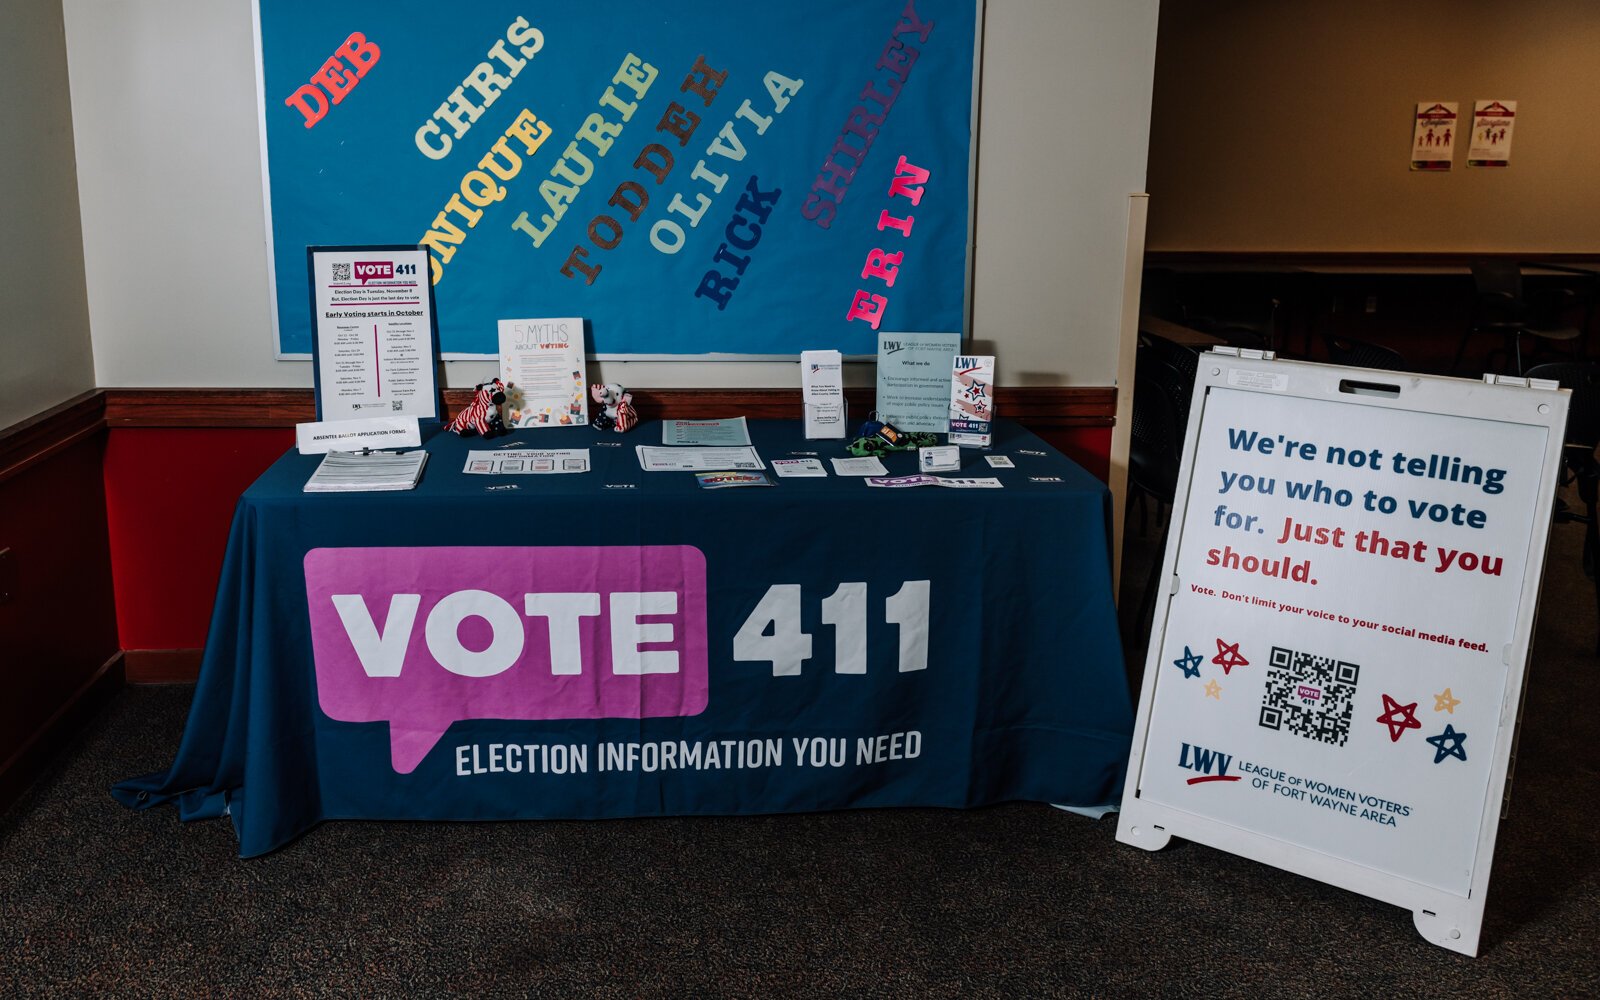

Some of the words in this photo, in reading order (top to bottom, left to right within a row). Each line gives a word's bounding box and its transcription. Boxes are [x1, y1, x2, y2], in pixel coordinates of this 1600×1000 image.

[285, 31, 381, 129] DEB
[414, 15, 545, 161] CHRIS
[801, 0, 935, 230] SHIRLEY
[511, 52, 659, 249] LAURIE
[650, 70, 804, 255] OLIVIA
[694, 175, 782, 311] RICK
[846, 155, 931, 330] ERIN
[356, 265, 392, 275] VOTE
[395, 264, 416, 275] 411
[343, 310, 367, 318] Voting
[514, 324, 524, 342] 5
[526, 323, 569, 343] MYTHS
[539, 342, 569, 350] VOTING
[883, 341, 902, 350] LWV
[955, 357, 978, 369] LWV
[313, 433, 338, 441] ABSENTEE
[357, 430, 388, 438] APPLICATION
[1227, 428, 1317, 461] We're
[1326, 441, 1383, 470] not
[1392, 451, 1507, 496] telling
[1218, 470, 1275, 495] you
[1285, 479, 1352, 507] who
[1363, 490, 1397, 514] to
[1408, 500, 1487, 529] vote
[1213, 504, 1265, 534] for.
[1277, 516, 1345, 548] Just
[1354, 529, 1426, 563] that
[1434, 547, 1504, 577] you
[1206, 545, 1318, 586] should.
[331, 589, 680, 678] VOTE
[733, 579, 931, 677] 411
[1190, 583, 1217, 597] Vote.
[1221, 590, 1250, 603] Don't
[1251, 595, 1277, 610] limit
[1279, 602, 1304, 616] your
[1306, 609, 1335, 622] voice
[1338, 614, 1350, 624] to
[1352, 618, 1380, 632] your
[1381, 622, 1416, 638] social
[1418, 629, 1456, 646] media
[1458, 638, 1489, 653] feed.
[1300, 687, 1320, 698] VOTE
[1302, 698, 1315, 706] 411
[455, 743, 589, 777] ELECTION
[598, 740, 788, 773] INFORMATION
[792, 737, 851, 769] YOU
[856, 730, 922, 766] NEED
[1178, 742, 1233, 777] LWV
[1238, 760, 1286, 783] LEAGUE
[1288, 775, 1303, 786] OF
[1304, 778, 1356, 802] WOMEN
[1251, 777, 1269, 790] OF
[1273, 783, 1307, 801] FORT
[1310, 794, 1357, 817] WAYNE
[1359, 807, 1396, 827] AREA
